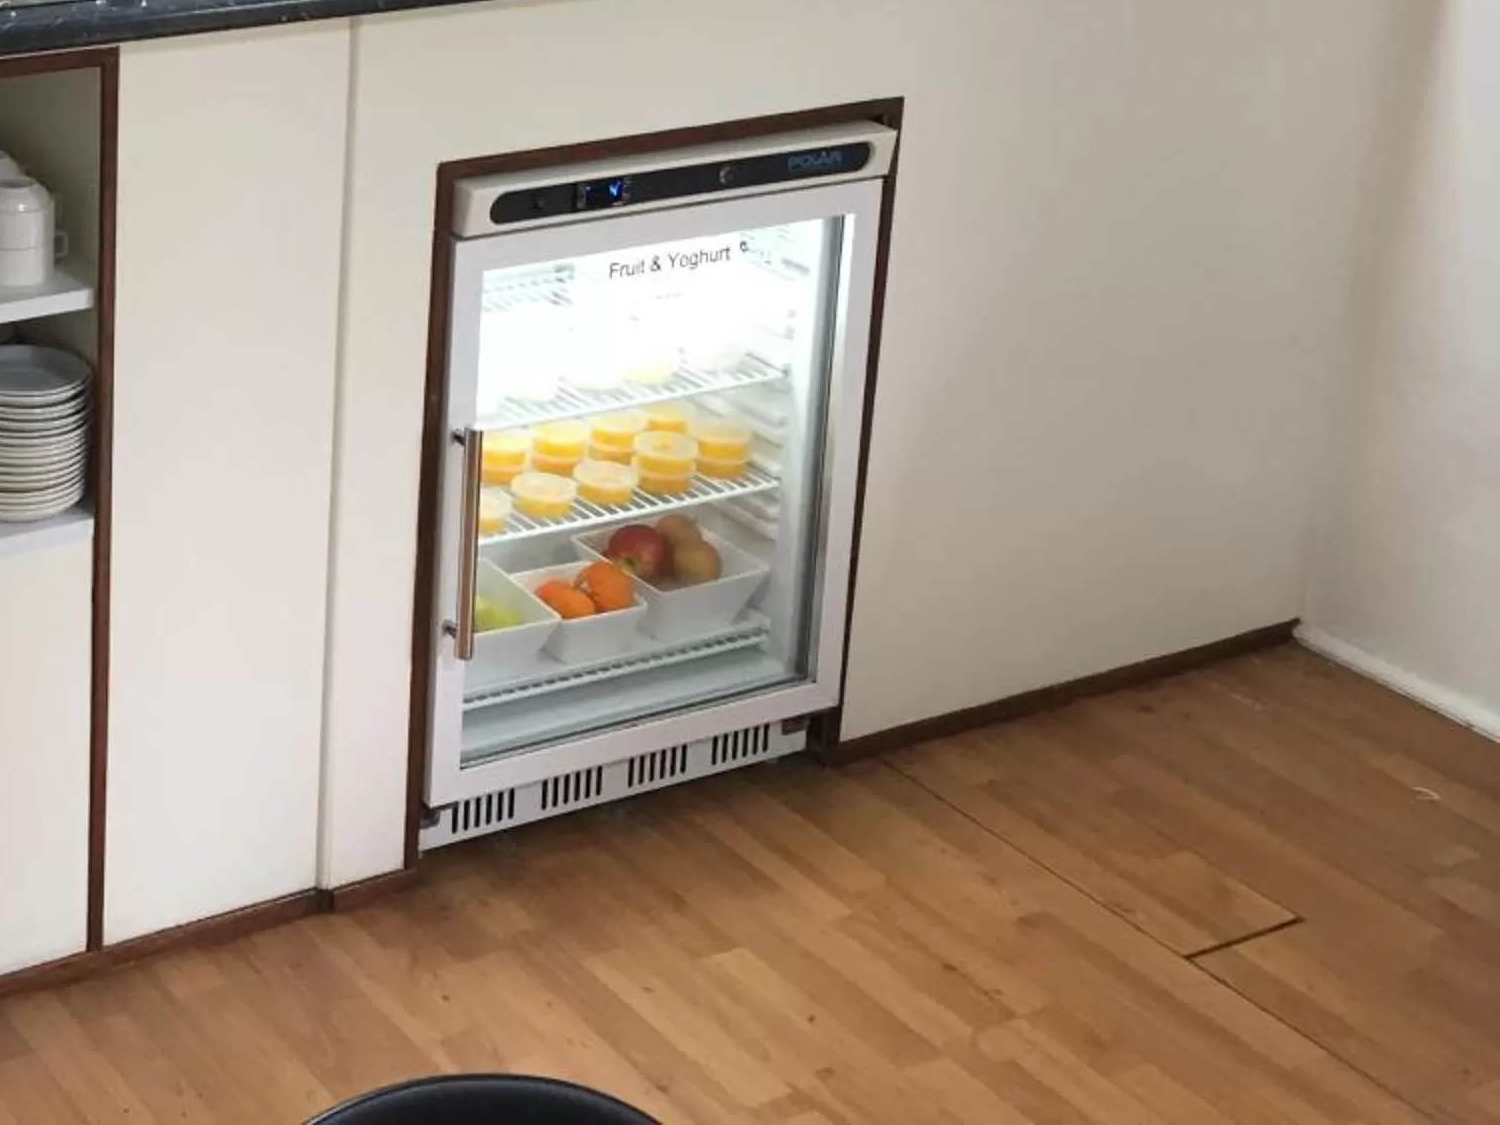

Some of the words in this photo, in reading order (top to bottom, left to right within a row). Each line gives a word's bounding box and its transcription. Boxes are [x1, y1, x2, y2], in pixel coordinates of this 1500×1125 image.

[609, 259, 645, 280] Fruit
[650, 254, 662, 272] &
[667, 246, 731, 271] Yoghurt
